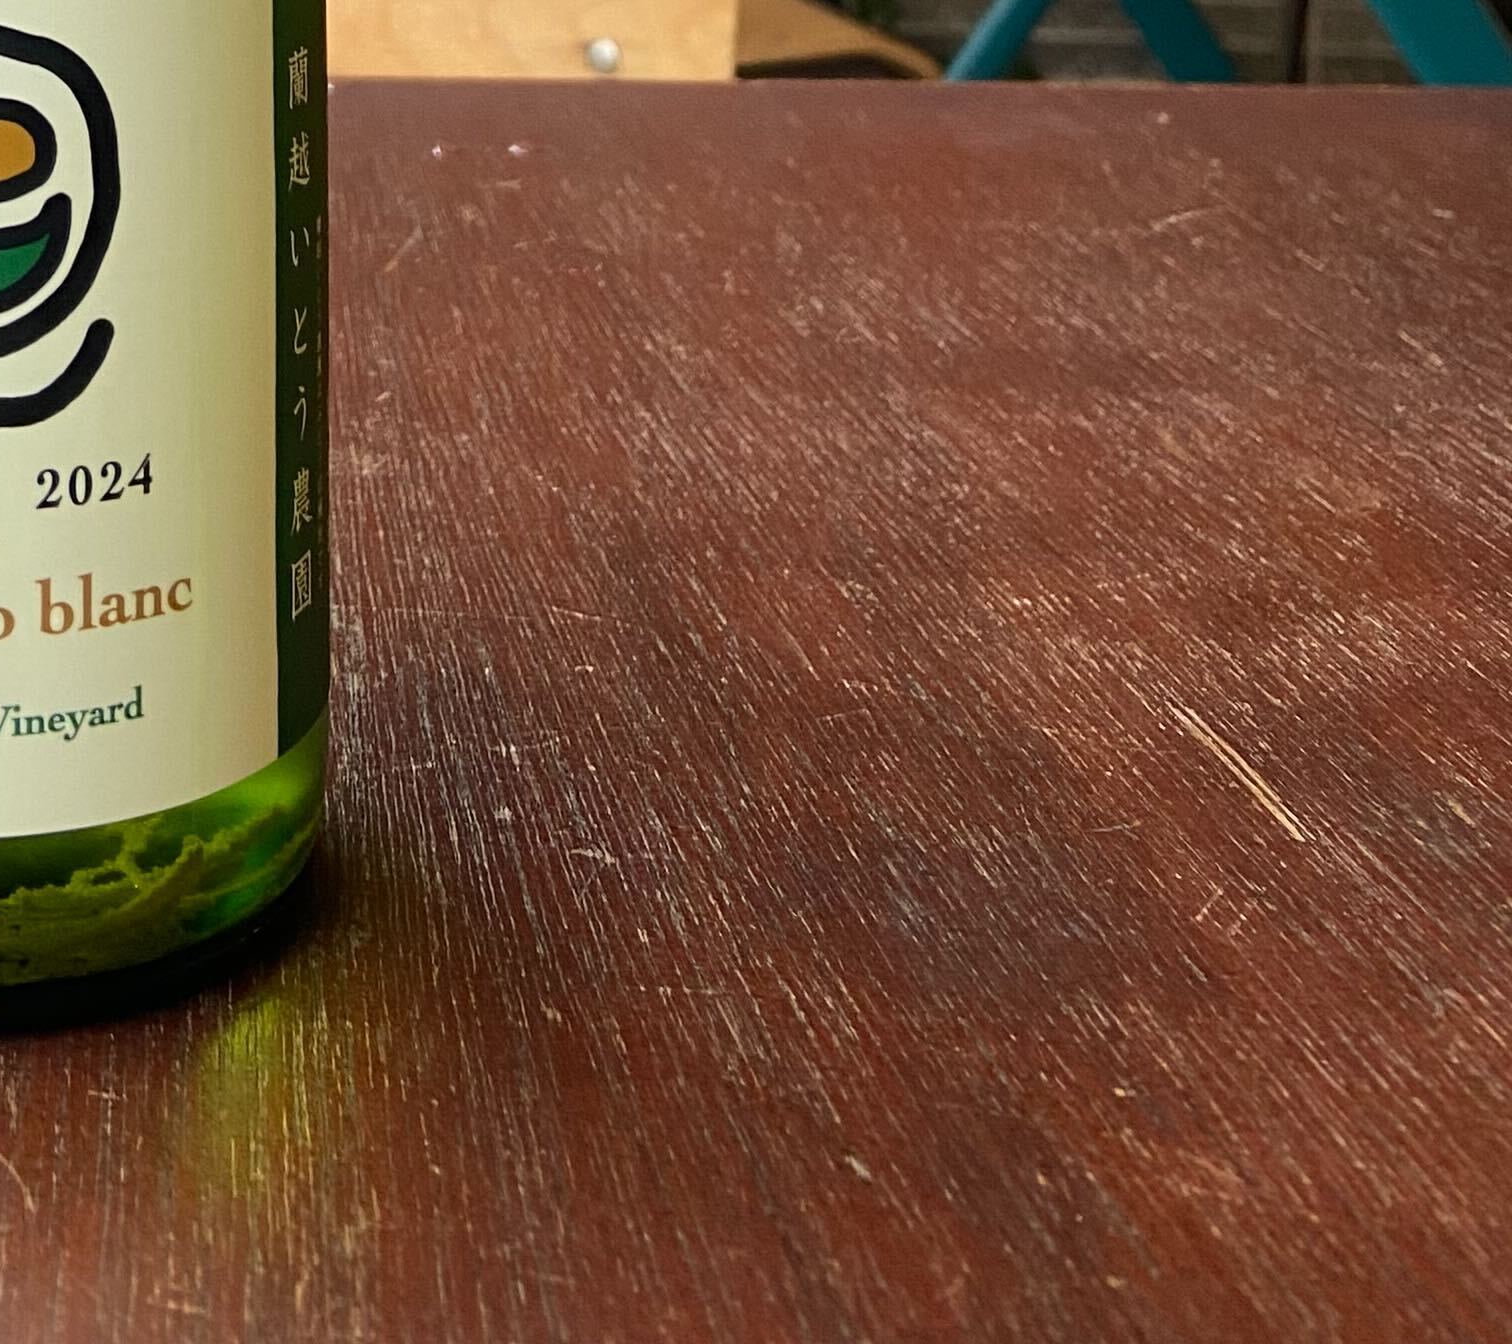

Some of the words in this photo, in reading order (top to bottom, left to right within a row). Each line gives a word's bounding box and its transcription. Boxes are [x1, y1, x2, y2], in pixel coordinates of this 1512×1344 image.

[287, 44, 314, 623] 蘭越いとう農園
[35, 452, 154, 510] 2024
[34, 571, 194, 637] blanc
